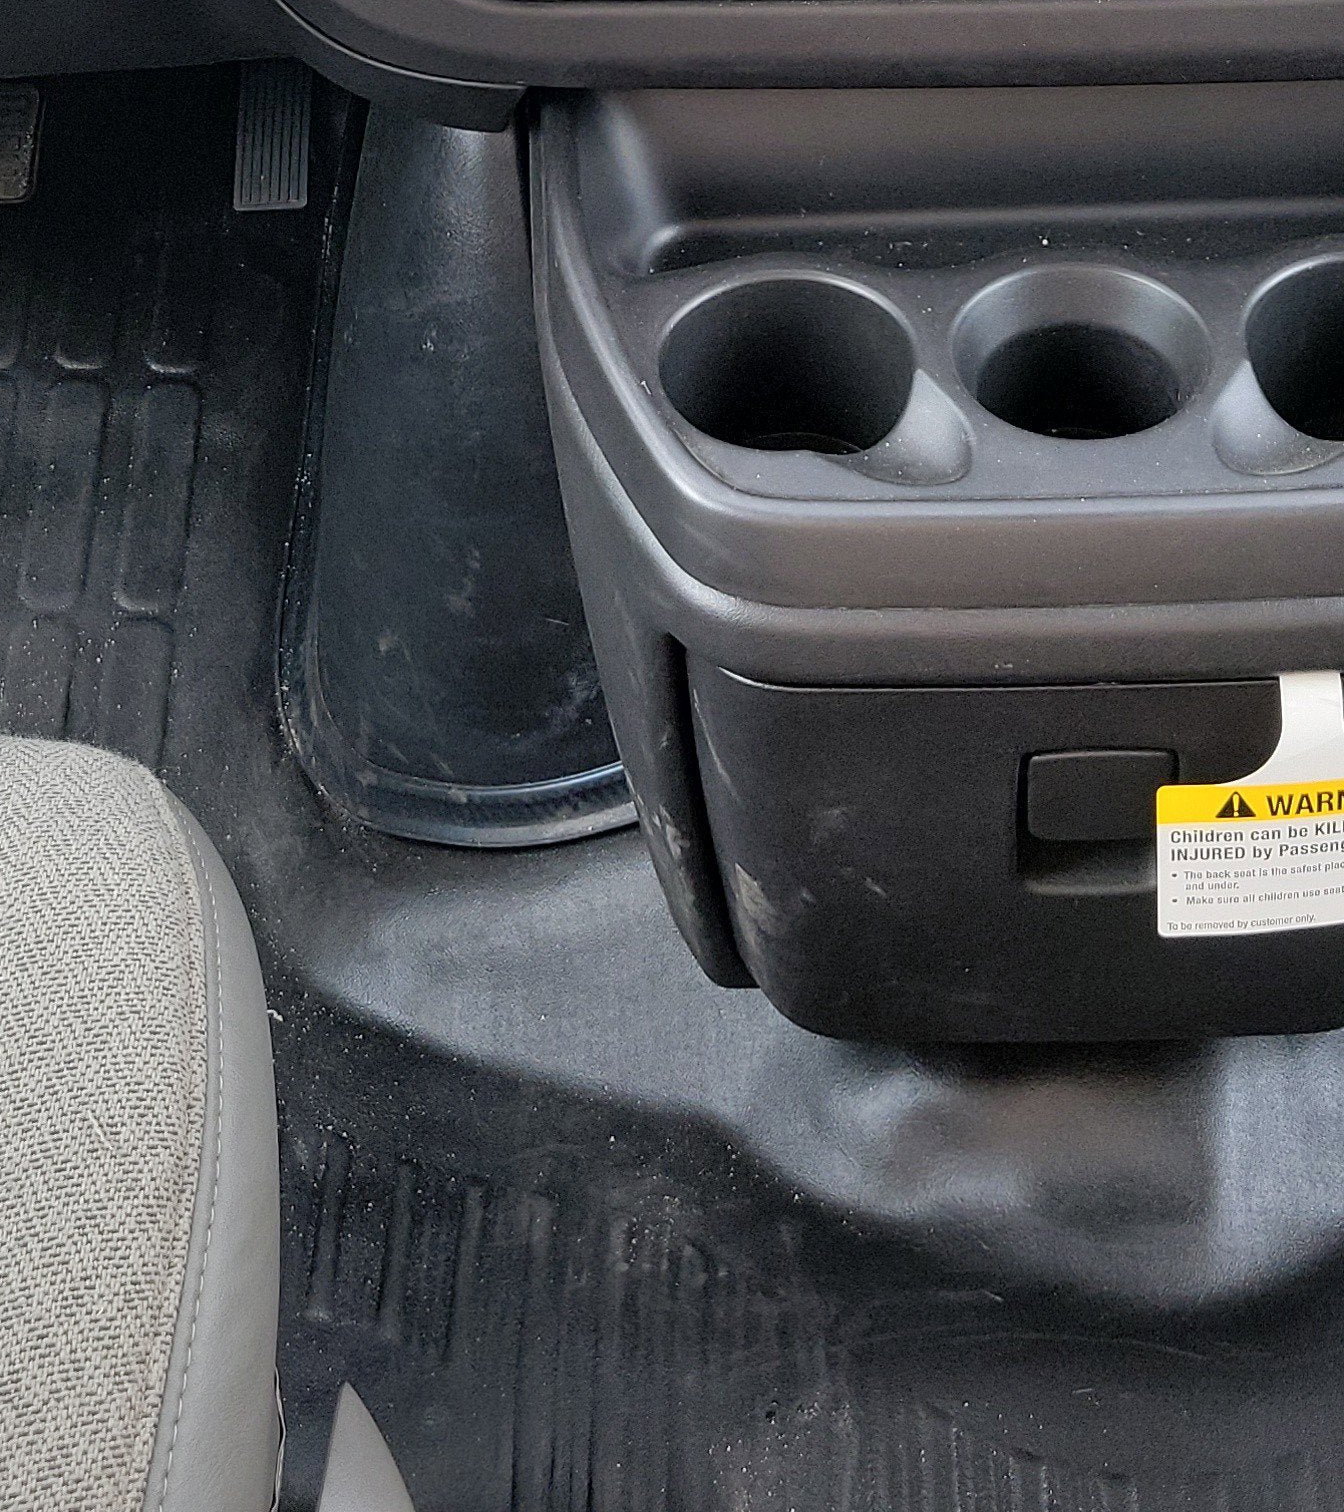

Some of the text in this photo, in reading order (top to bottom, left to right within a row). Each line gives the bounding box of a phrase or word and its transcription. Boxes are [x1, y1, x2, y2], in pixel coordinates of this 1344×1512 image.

[1170, 829, 1244, 844] Children
[1250, 829, 1281, 841] can
[1288, 825, 1308, 839] be
[1170, 846, 1246, 861] INJURED
[1253, 846, 1273, 861] by
[1184, 870, 1203, 880] The
[1206, 869, 1231, 879] back
[1234, 868, 1256, 878] seat
[1259, 867, 1268, 877] is
[1271, 866, 1287, 876] the
[1290, 862, 1321, 875] safest
[1185, 880, 1240, 891] and under.
[1186, 895, 1213, 906] Make
[1217, 896, 1239, 905] sure
[1243, 893, 1256, 903] all
[1258, 891, 1299, 903] children
[1302, 889, 1320, 898] use
[1323, 885, 1344, 896] seat
[1167, 913, 1316, 931] To be removed by customer only.
